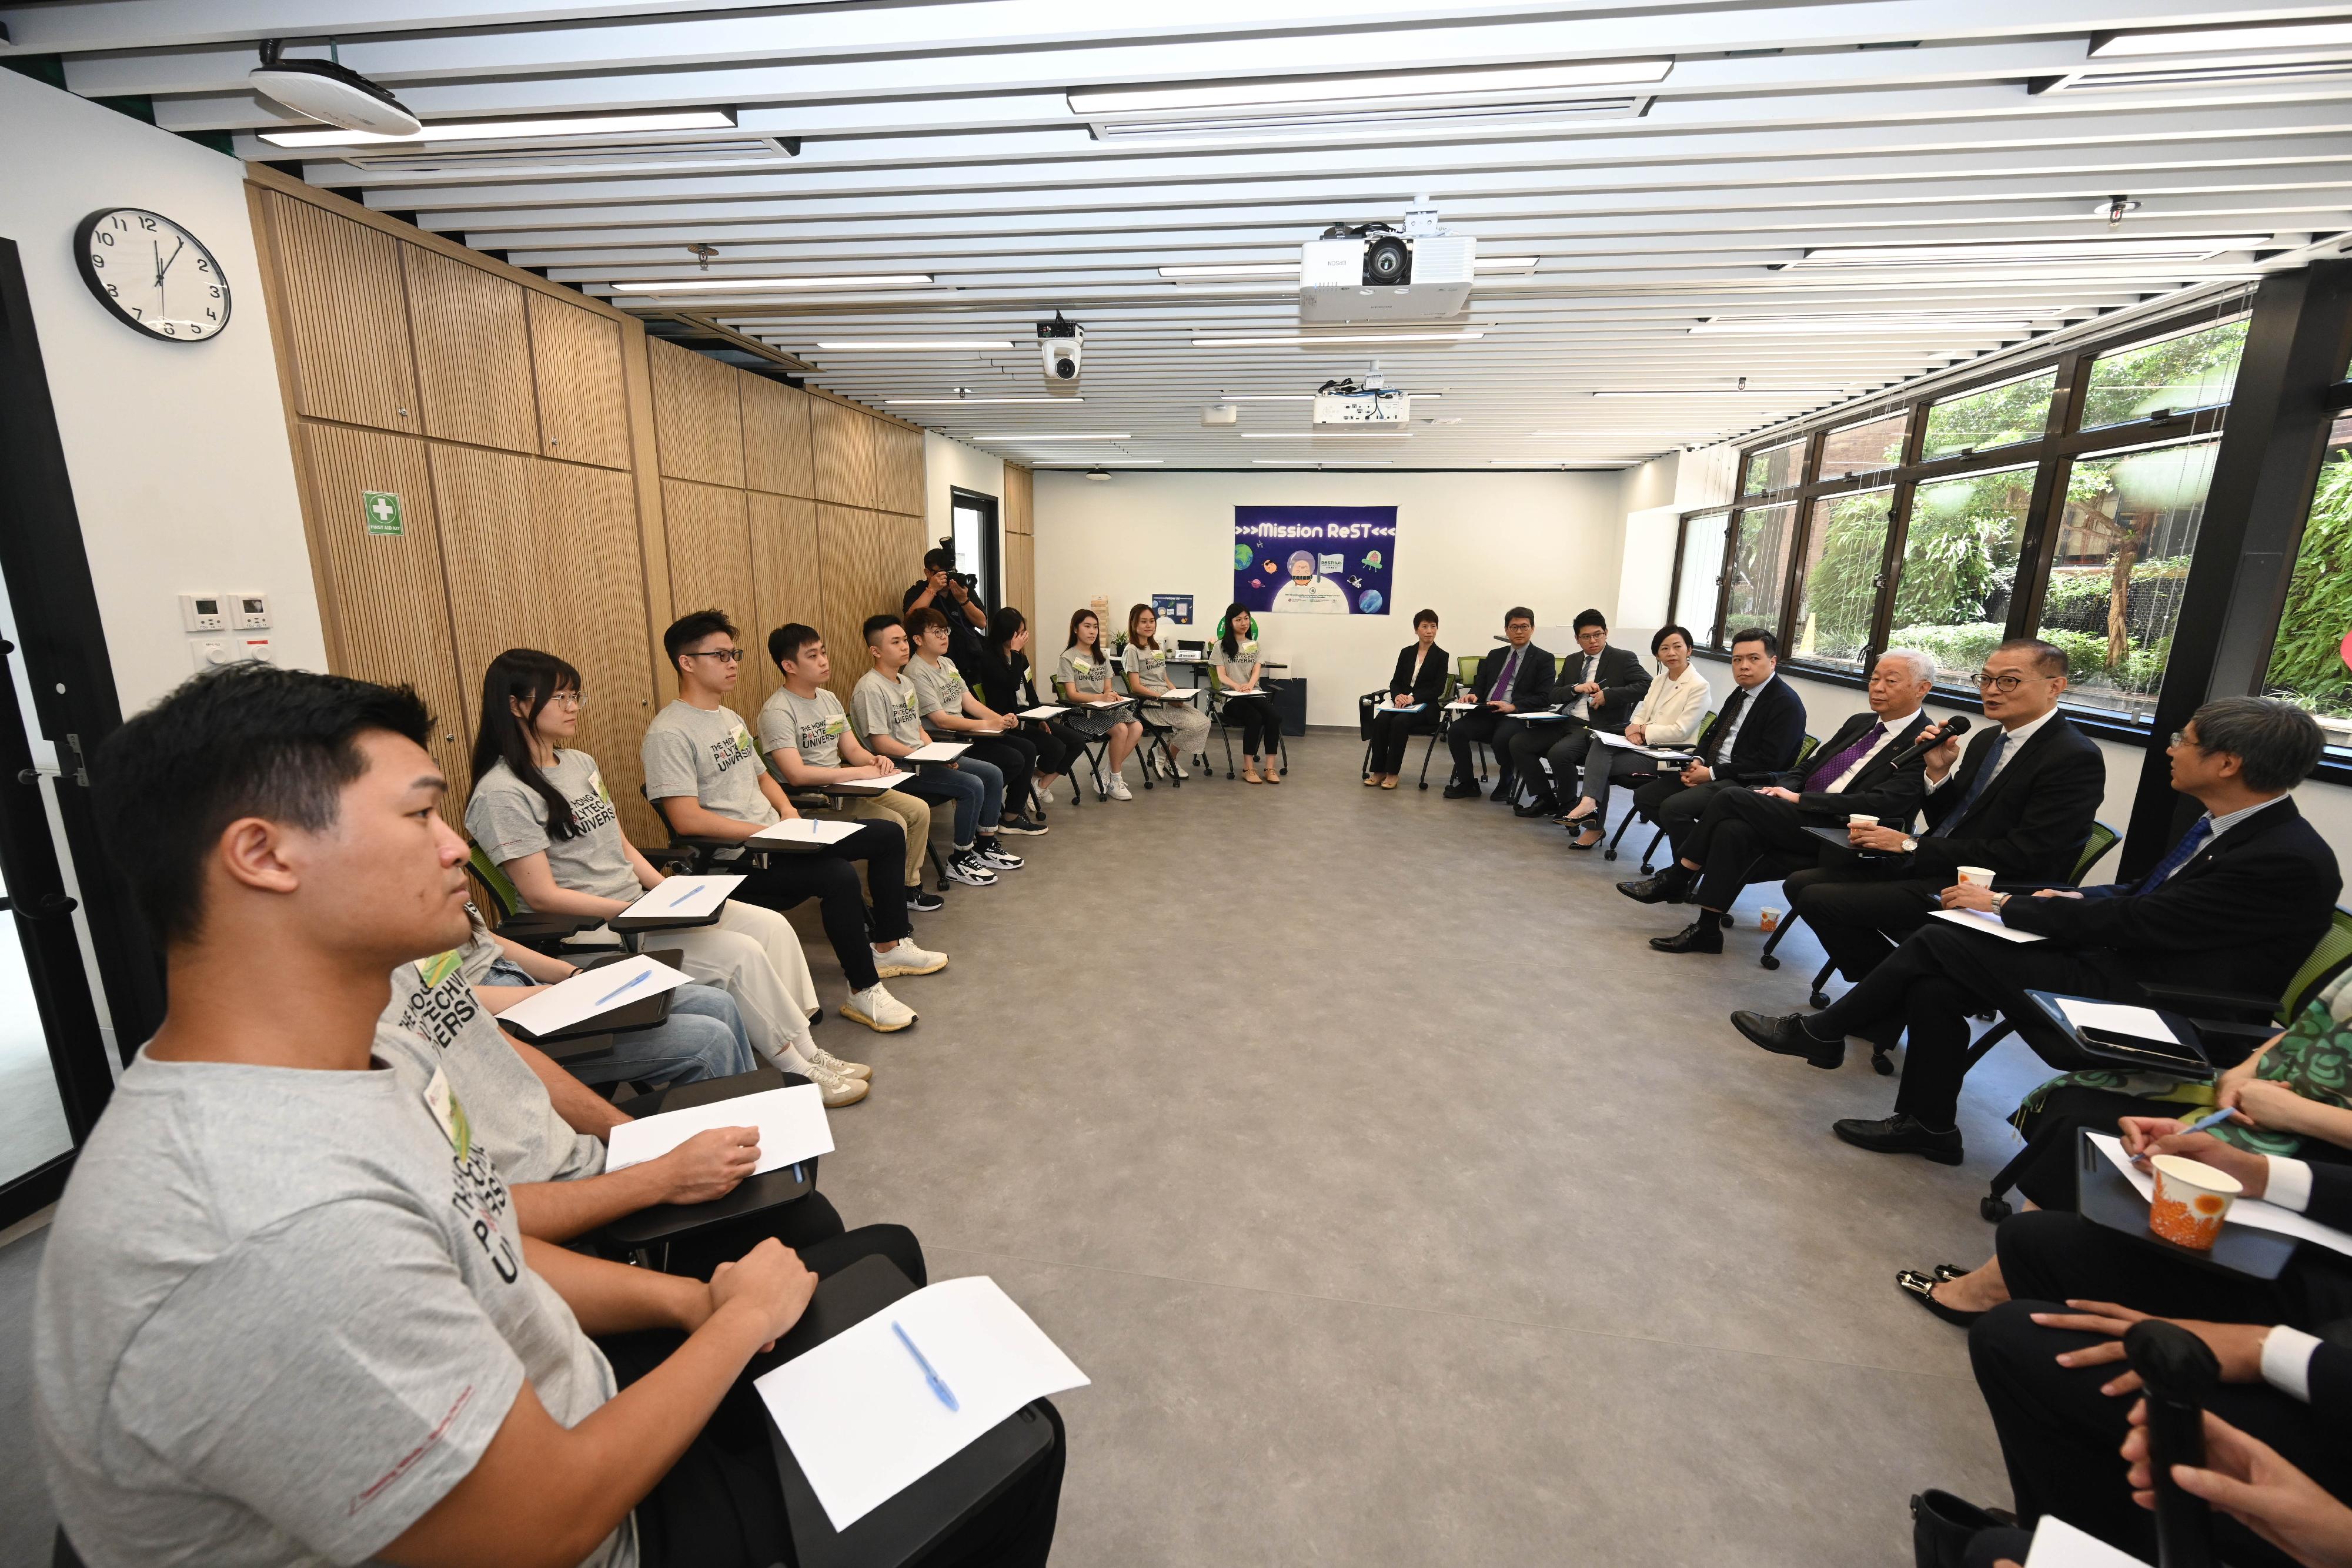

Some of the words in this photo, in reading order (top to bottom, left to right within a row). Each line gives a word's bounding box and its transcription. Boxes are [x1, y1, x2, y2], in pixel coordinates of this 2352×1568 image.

[112, 216, 127, 231] 11
[139, 216, 156, 232] 12
[95, 230, 114, 246] 10
[92, 254, 104, 268] 9
[198, 259, 209, 272] 2
[107, 284, 119, 297] 8
[209, 286, 220, 298] 3
[132, 307, 142, 320] 7
[206, 307, 216, 320] 4
[1258, 523, 1323, 538] Mission
[1328, 523, 1372, 538] ReST
[1147, 661, 1164, 670] UNIVERS
[803, 728, 826, 740] POLYTE
[710, 742, 723, 752] THE
[723, 735, 735, 747] HON
[564, 808, 616, 839] UNIVERS
